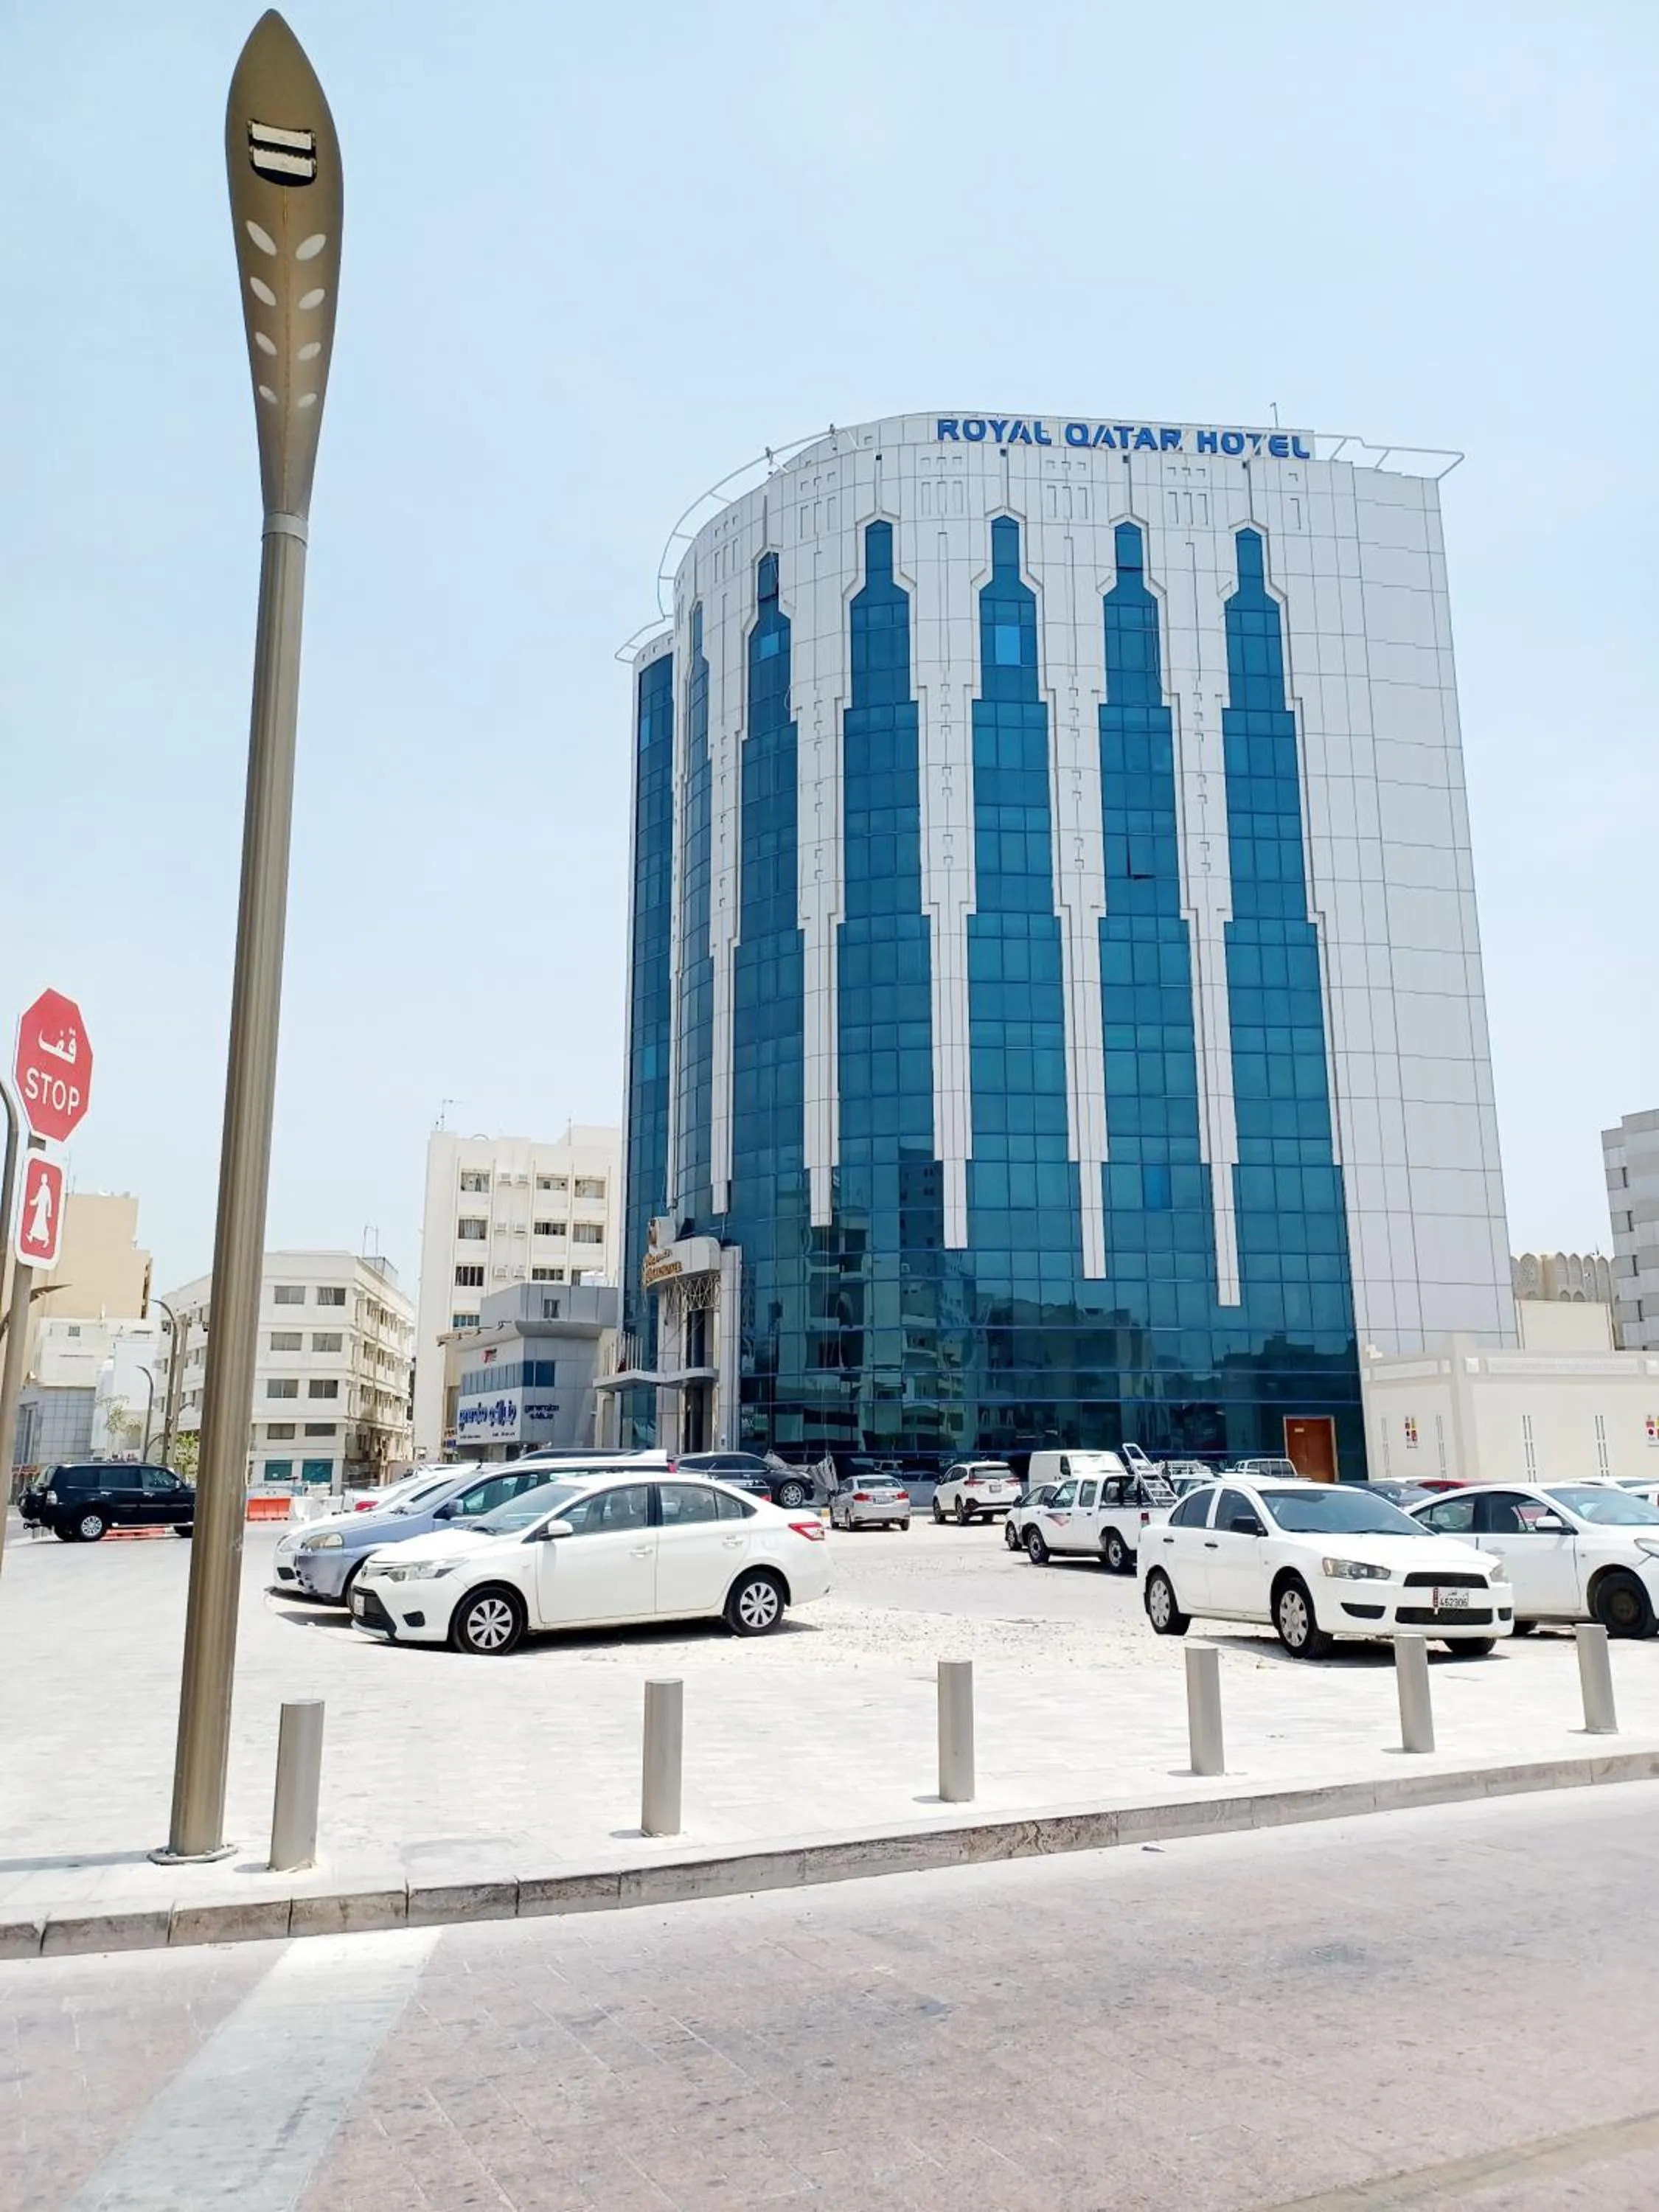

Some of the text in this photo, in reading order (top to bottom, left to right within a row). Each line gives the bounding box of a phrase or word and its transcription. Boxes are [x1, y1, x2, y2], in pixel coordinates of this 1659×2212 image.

[937, 419, 1310, 459] ROYAL QATAR HOTEL
[38, 1026, 77, 1065] قف
[25, 1067, 80, 1116] STOP
